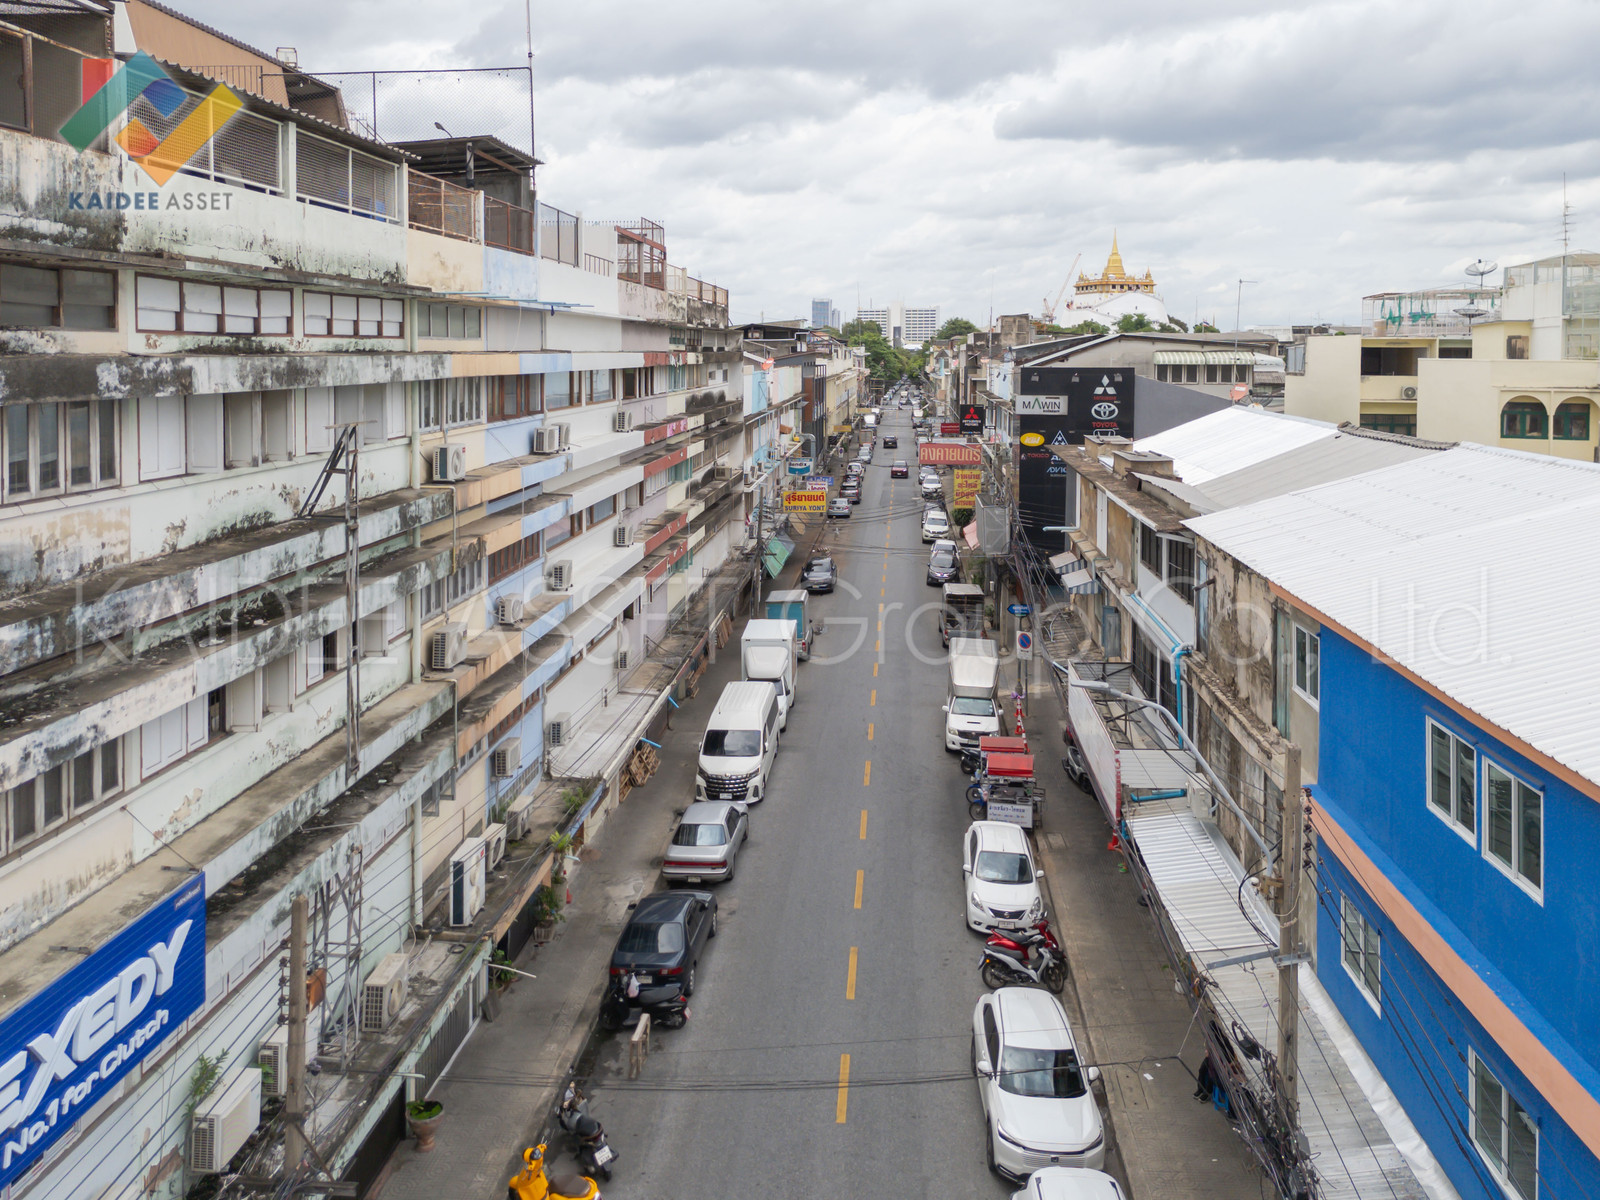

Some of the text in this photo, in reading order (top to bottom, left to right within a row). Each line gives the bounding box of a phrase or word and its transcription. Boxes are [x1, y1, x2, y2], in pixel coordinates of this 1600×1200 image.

[1022, 398, 1061, 410] MAWIN
[0, 919, 193, 1134] EXEDY
[60, 1071, 100, 1115] for
[100, 1009, 170, 1080] Clutch
